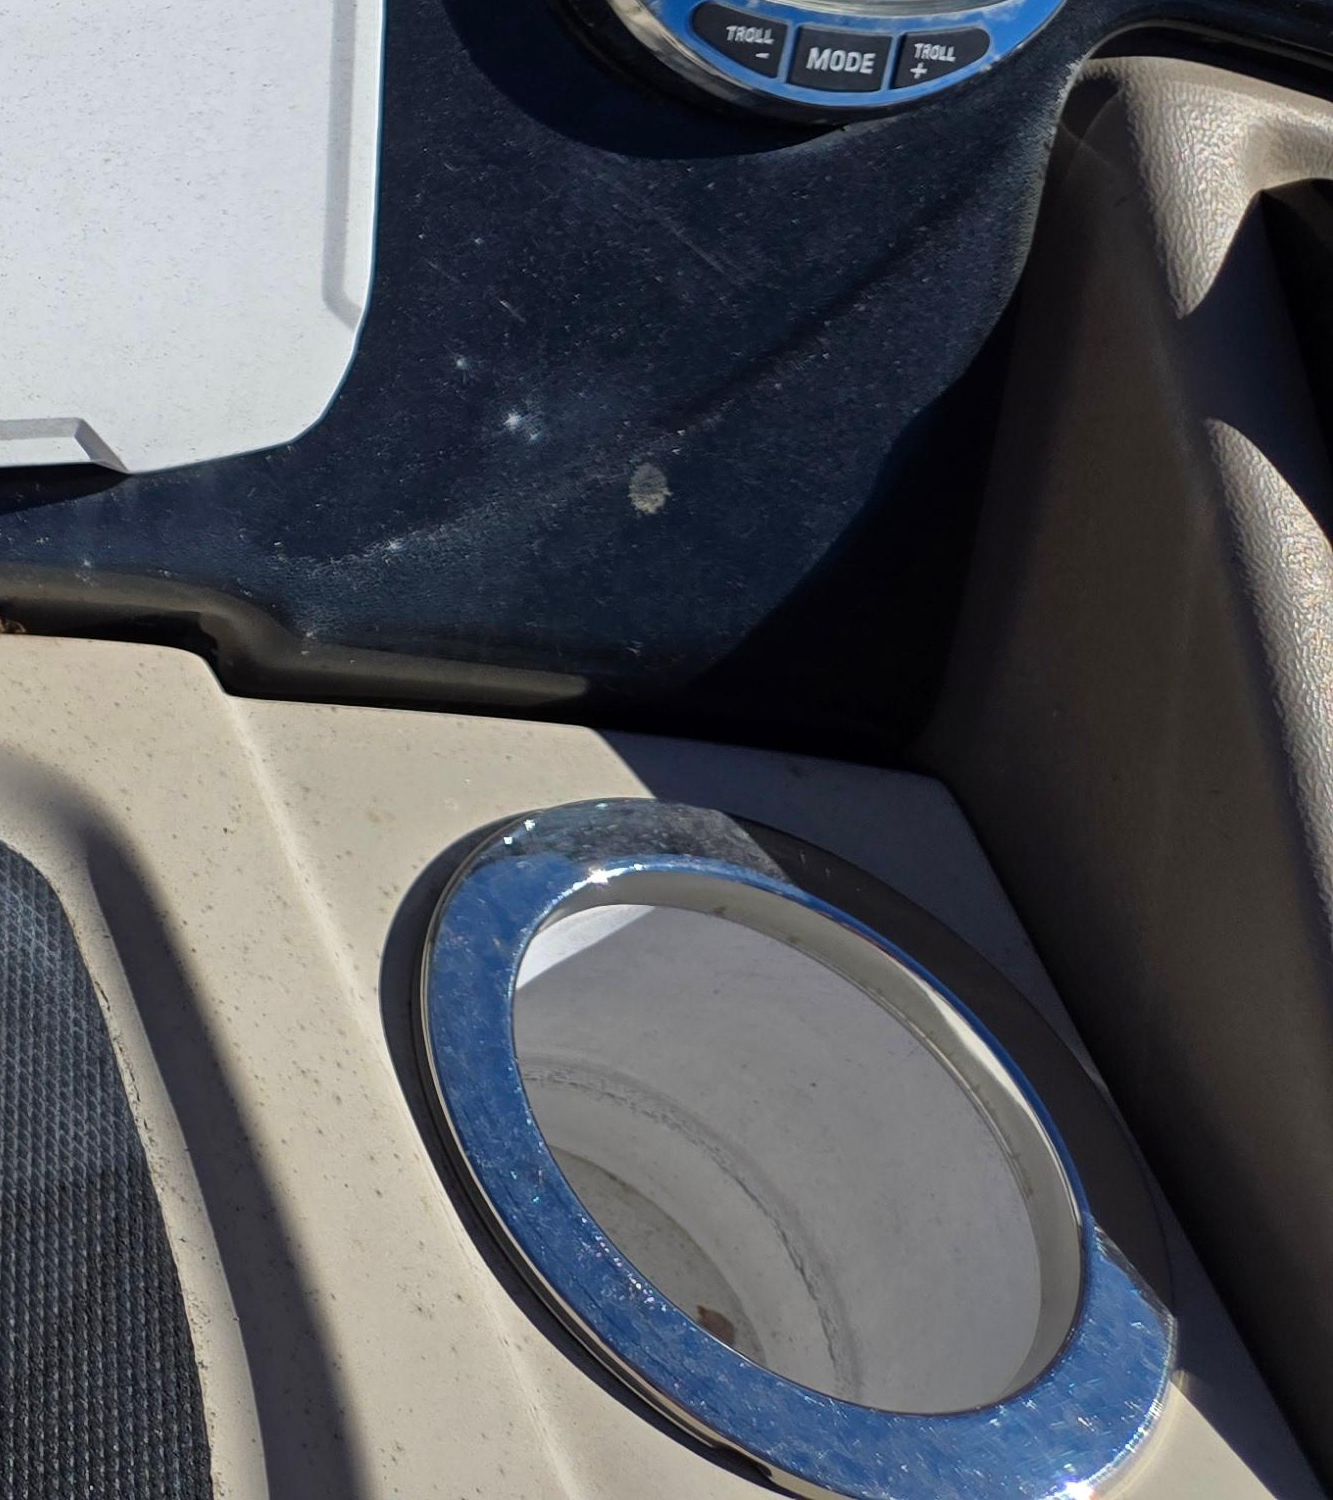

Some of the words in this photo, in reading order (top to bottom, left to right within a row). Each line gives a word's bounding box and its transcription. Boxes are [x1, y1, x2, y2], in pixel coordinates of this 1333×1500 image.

[726, 24, 775, 46] TROLL
[805, 47, 876, 76] MODE
[913, 42, 958, 64] TROLL
